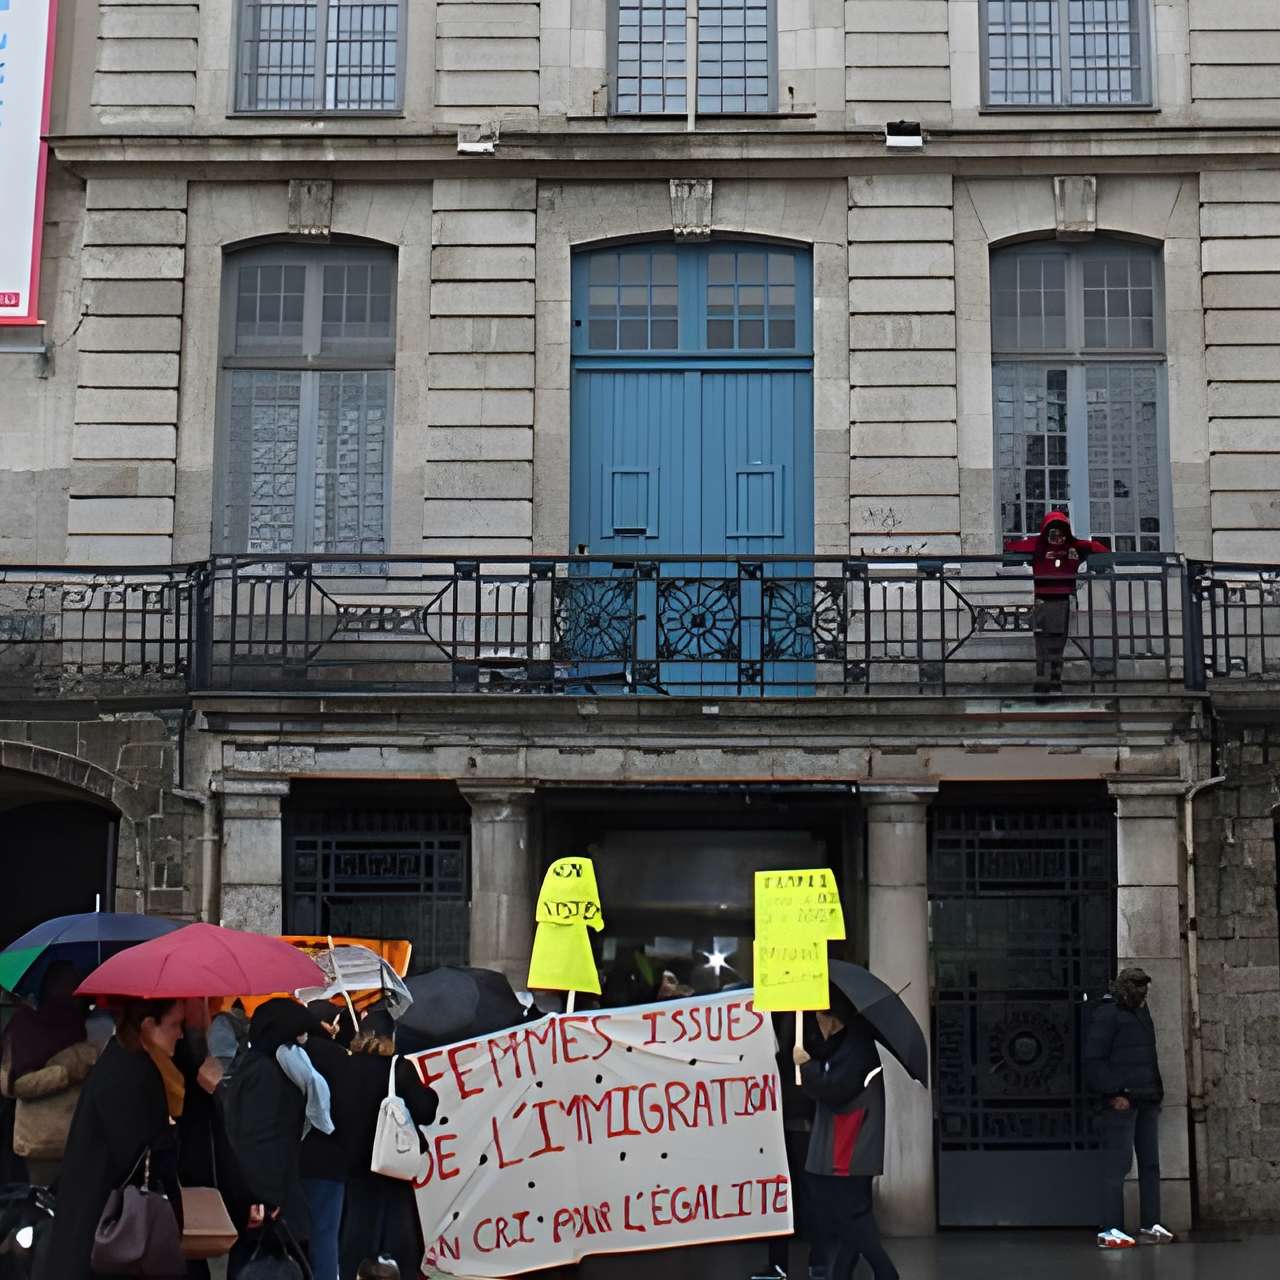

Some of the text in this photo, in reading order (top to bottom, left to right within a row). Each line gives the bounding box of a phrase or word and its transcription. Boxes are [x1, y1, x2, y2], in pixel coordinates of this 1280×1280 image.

[418, 1000, 764, 1099] FEMMES ISSUES
[473, 1211, 535, 1252] CRI
